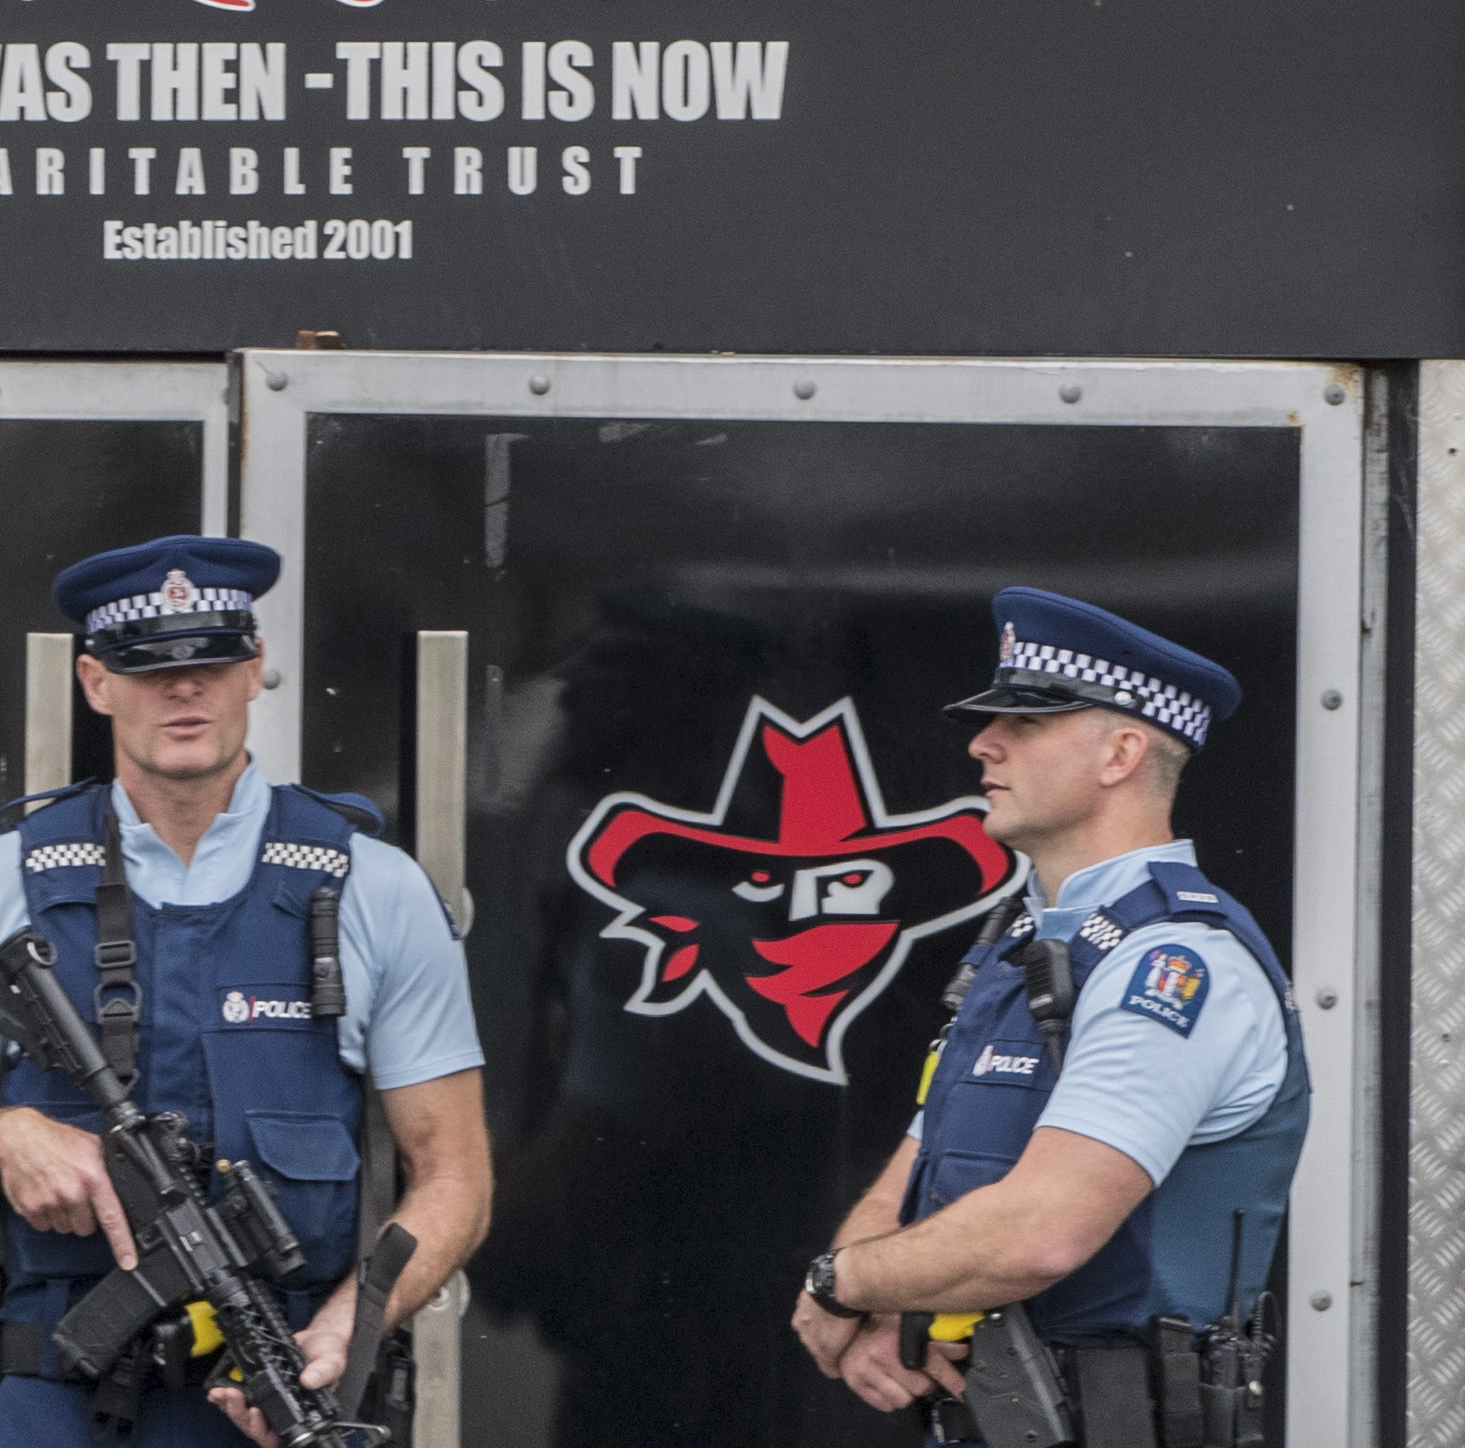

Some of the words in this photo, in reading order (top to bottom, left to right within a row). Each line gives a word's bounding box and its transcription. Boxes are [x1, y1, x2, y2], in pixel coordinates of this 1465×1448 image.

[106, 42, 287, 122] THEN
[521, 40, 596, 122] IS
[611, 40, 791, 122] NOW
[402, 145, 644, 196] TRUST
[103, 219, 318, 261] Established
[322, 219, 414, 261] 2001
[251, 1000, 312, 1019] POLICE
[991, 1055, 1040, 1075] POLICE
